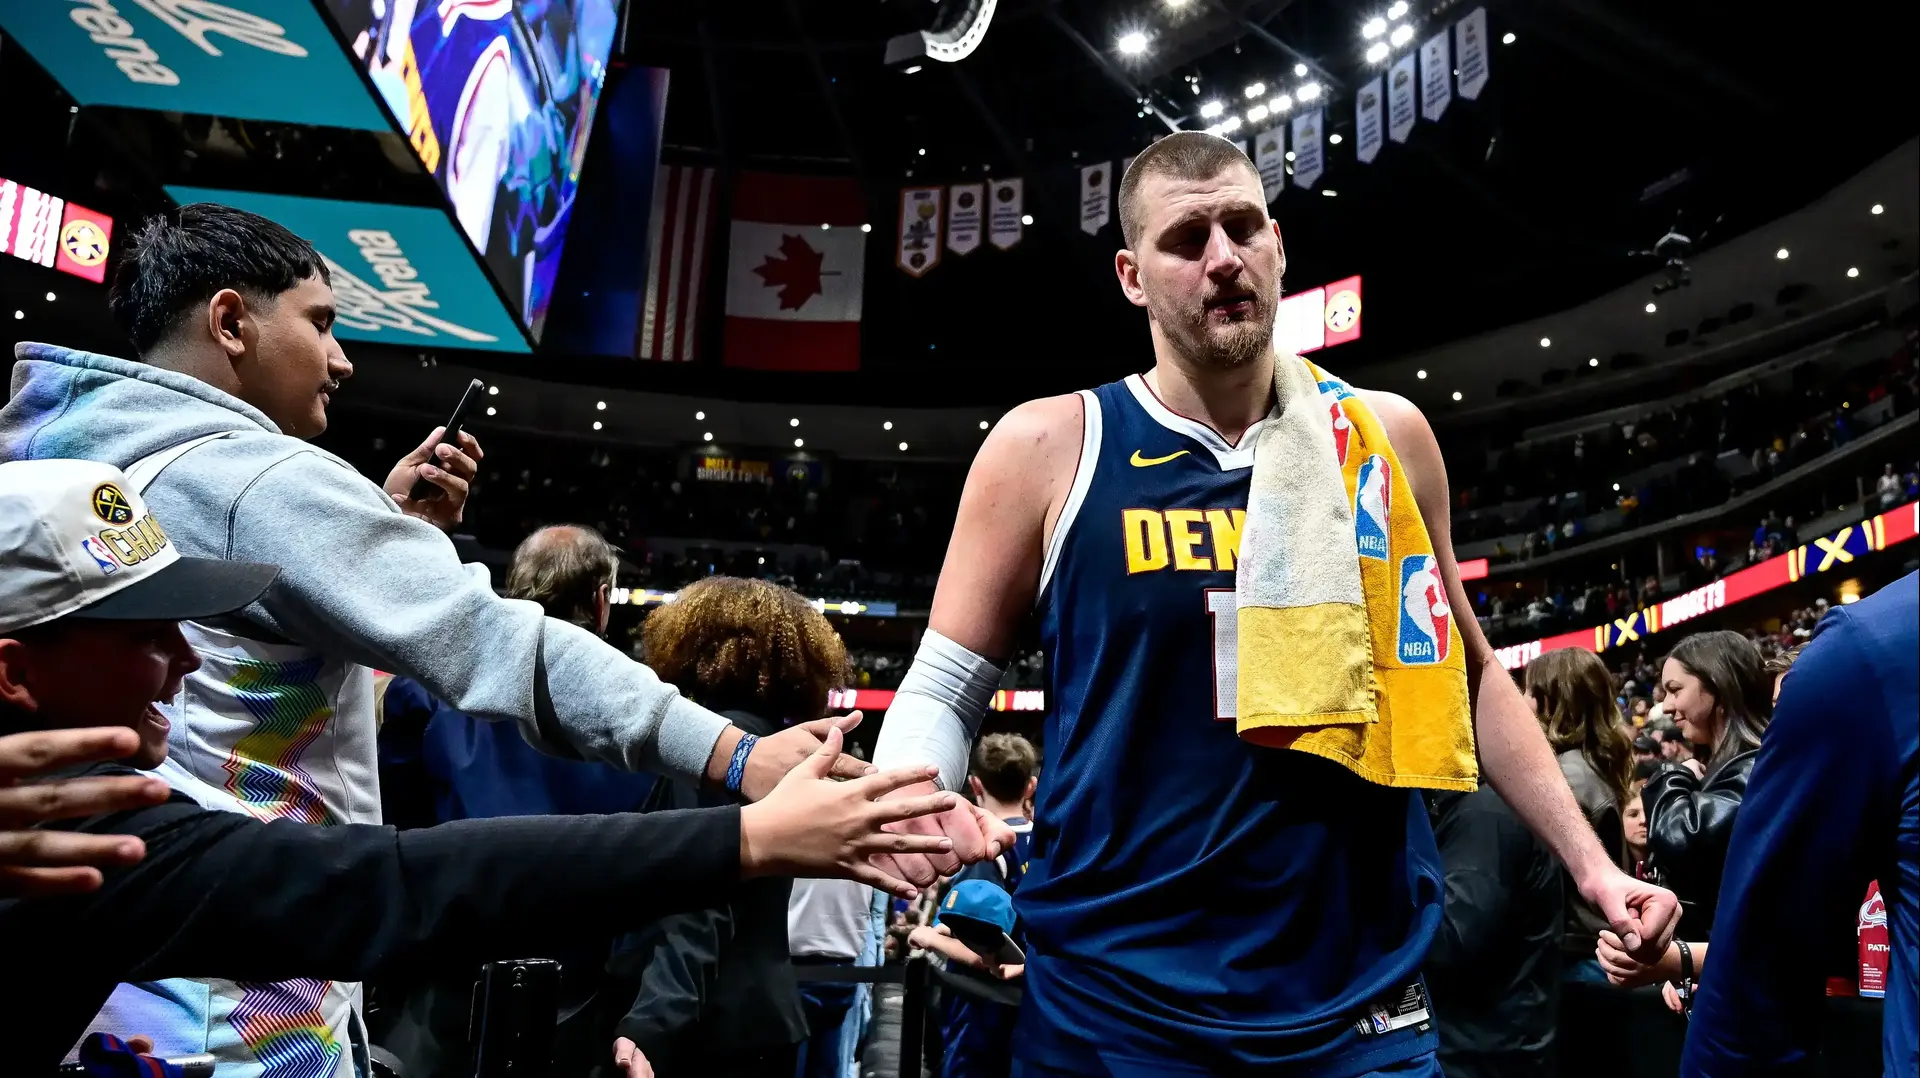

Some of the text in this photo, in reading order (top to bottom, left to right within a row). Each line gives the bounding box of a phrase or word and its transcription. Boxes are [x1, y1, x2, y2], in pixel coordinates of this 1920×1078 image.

[347, 228, 441, 309] Arena
[1359, 534, 1387, 553] NBA
[1402, 640, 1432, 657] NBA
[1867, 943, 1891, 952] PATH
